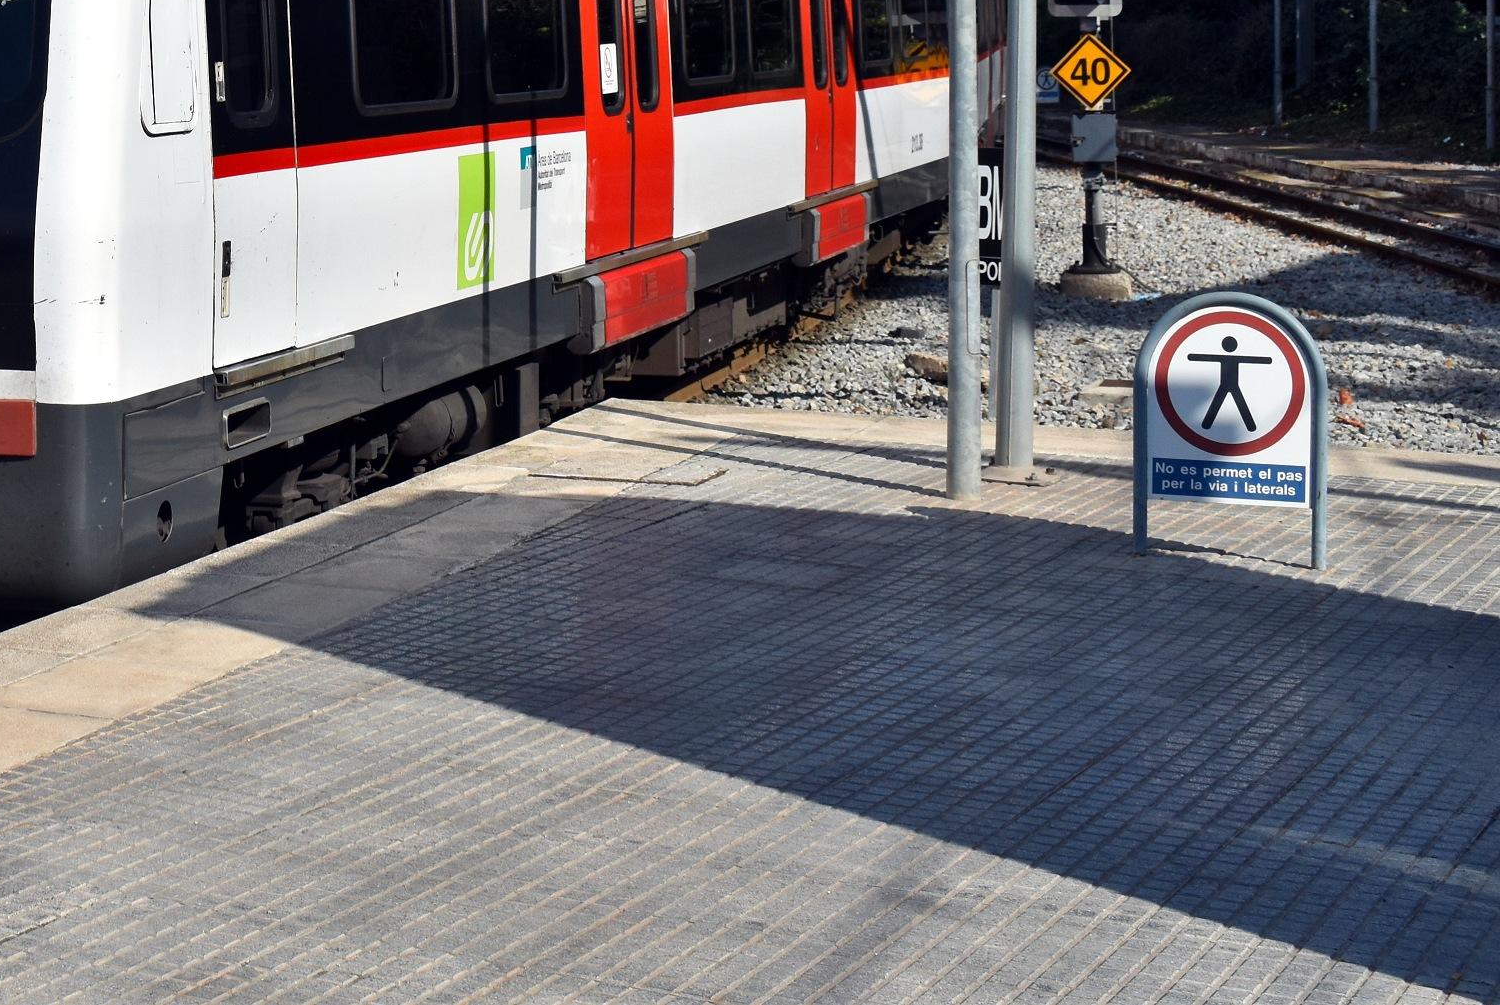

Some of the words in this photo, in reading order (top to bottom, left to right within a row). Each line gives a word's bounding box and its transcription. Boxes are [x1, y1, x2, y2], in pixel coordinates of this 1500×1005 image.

[1071, 57, 1111, 86] 40
[1155, 462, 1174, 475] No
[1180, 464, 1197, 475] es
[1203, 466, 1253, 479] permet
[1258, 468, 1271, 480] el
[1277, 471, 1303, 483] pas
[1161, 480, 1185, 490] per
[1190, 479, 1203, 490] la
[1208, 480, 1228, 492] via
[1233, 481, 1238, 493] i
[1244, 481, 1296, 496] laterals
